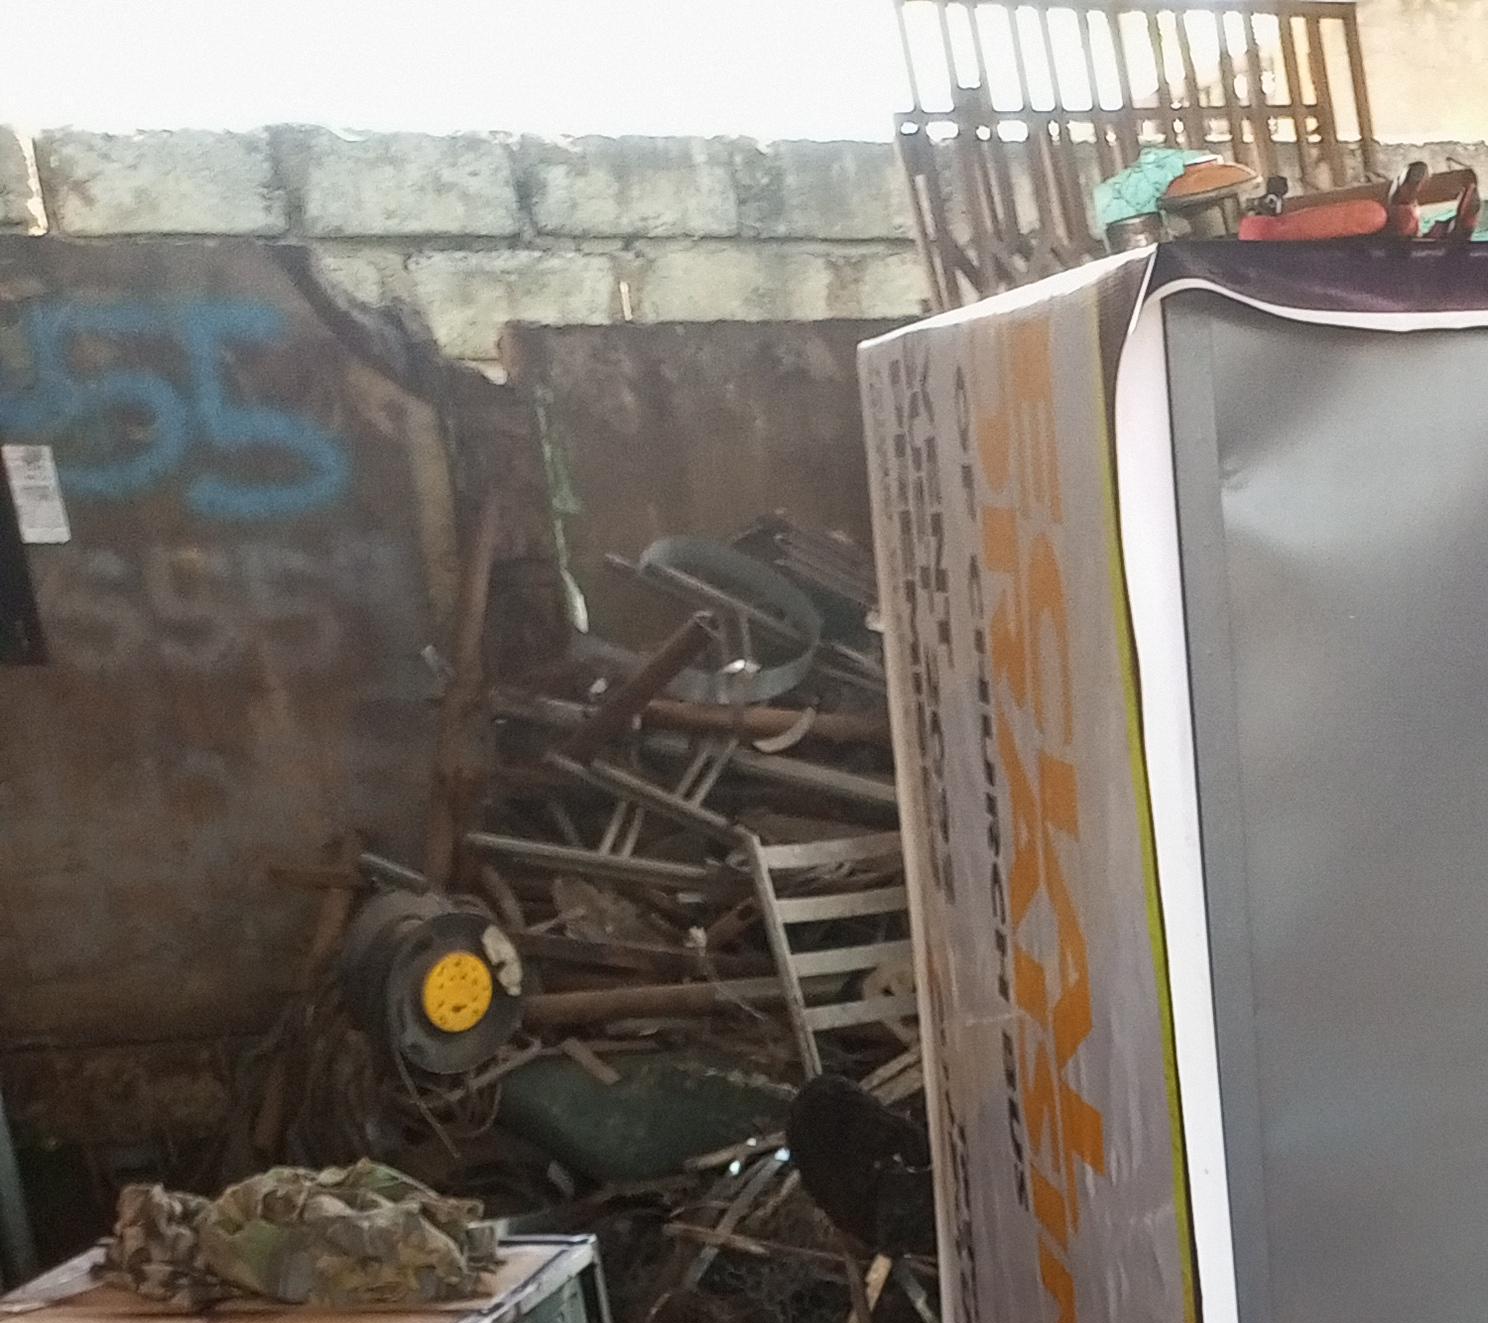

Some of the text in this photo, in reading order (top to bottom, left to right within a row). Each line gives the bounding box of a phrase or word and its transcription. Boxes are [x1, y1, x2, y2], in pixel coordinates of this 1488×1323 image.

[951, 364, 1029, 1215] OF CHURCH BUS
